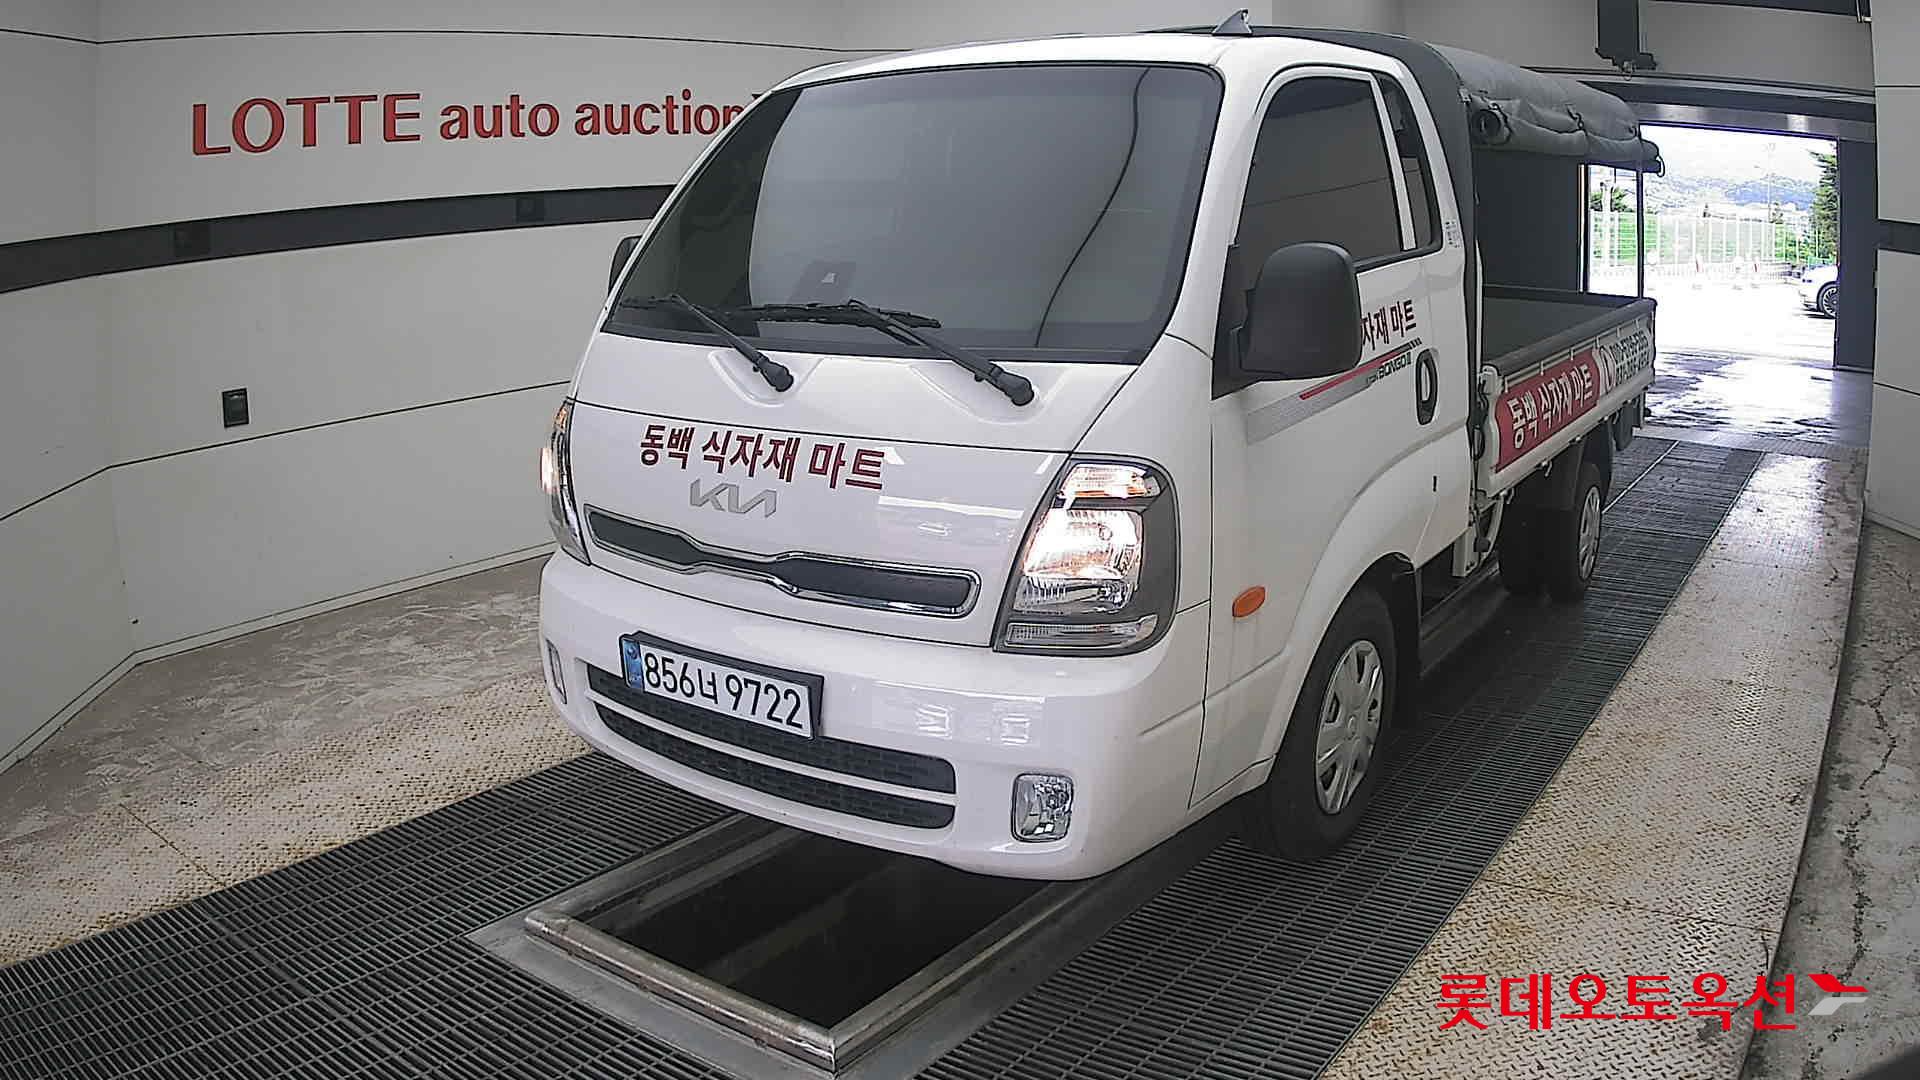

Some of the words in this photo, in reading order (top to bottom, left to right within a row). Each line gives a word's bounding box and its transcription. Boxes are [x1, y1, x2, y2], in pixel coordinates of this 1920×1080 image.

[192, 93, 422, 156] LOTTE
[439, 94, 561, 140] auto
[1390, 299, 1417, 338] 마트
[1507, 390, 1537, 449] 동백
[1538, 371, 1573, 429] 식자재
[1571, 363, 1593, 408] 마트
[640, 424, 695, 470] 동백
[701, 430, 801, 483] 식자재
[807, 442, 885, 490] 마트
[724, 674, 803, 730] 9722
